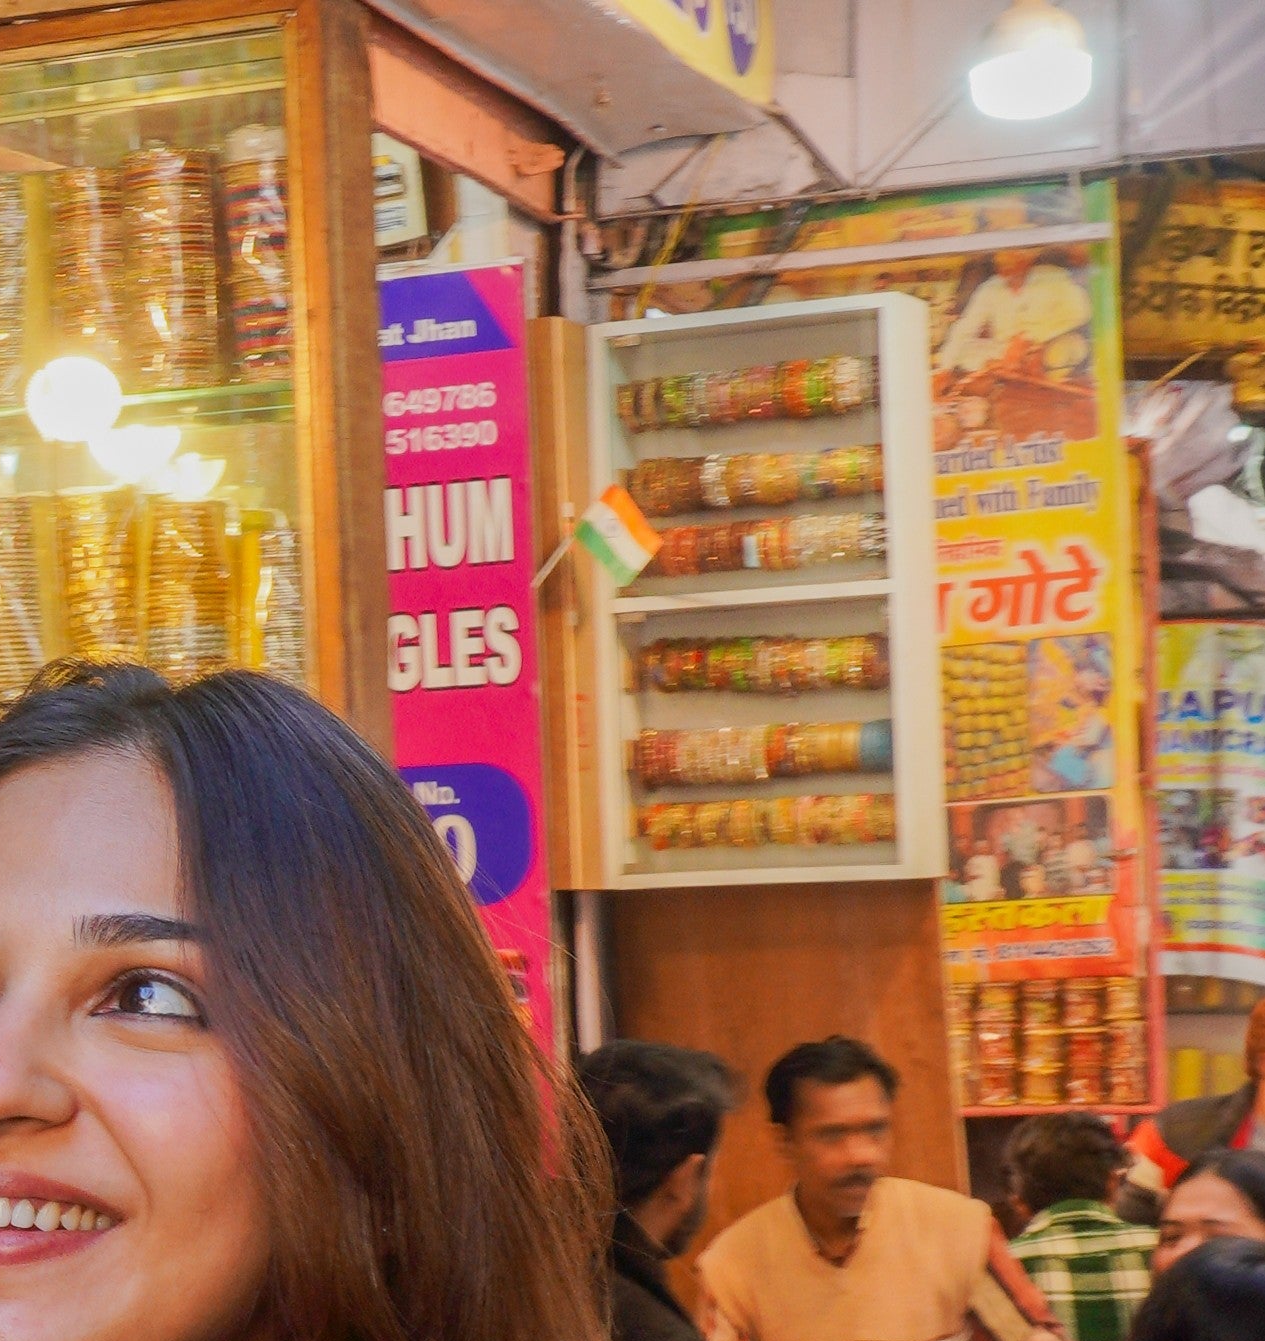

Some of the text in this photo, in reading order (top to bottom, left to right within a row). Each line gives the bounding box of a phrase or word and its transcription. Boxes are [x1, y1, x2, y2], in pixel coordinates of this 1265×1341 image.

[385, 475, 515, 573] HUM
[976, 481, 1020, 515] with
[1026, 473, 1102, 513] Family
[969, 544, 1101, 627] गोटे
[387, 603, 522, 693] GLES
